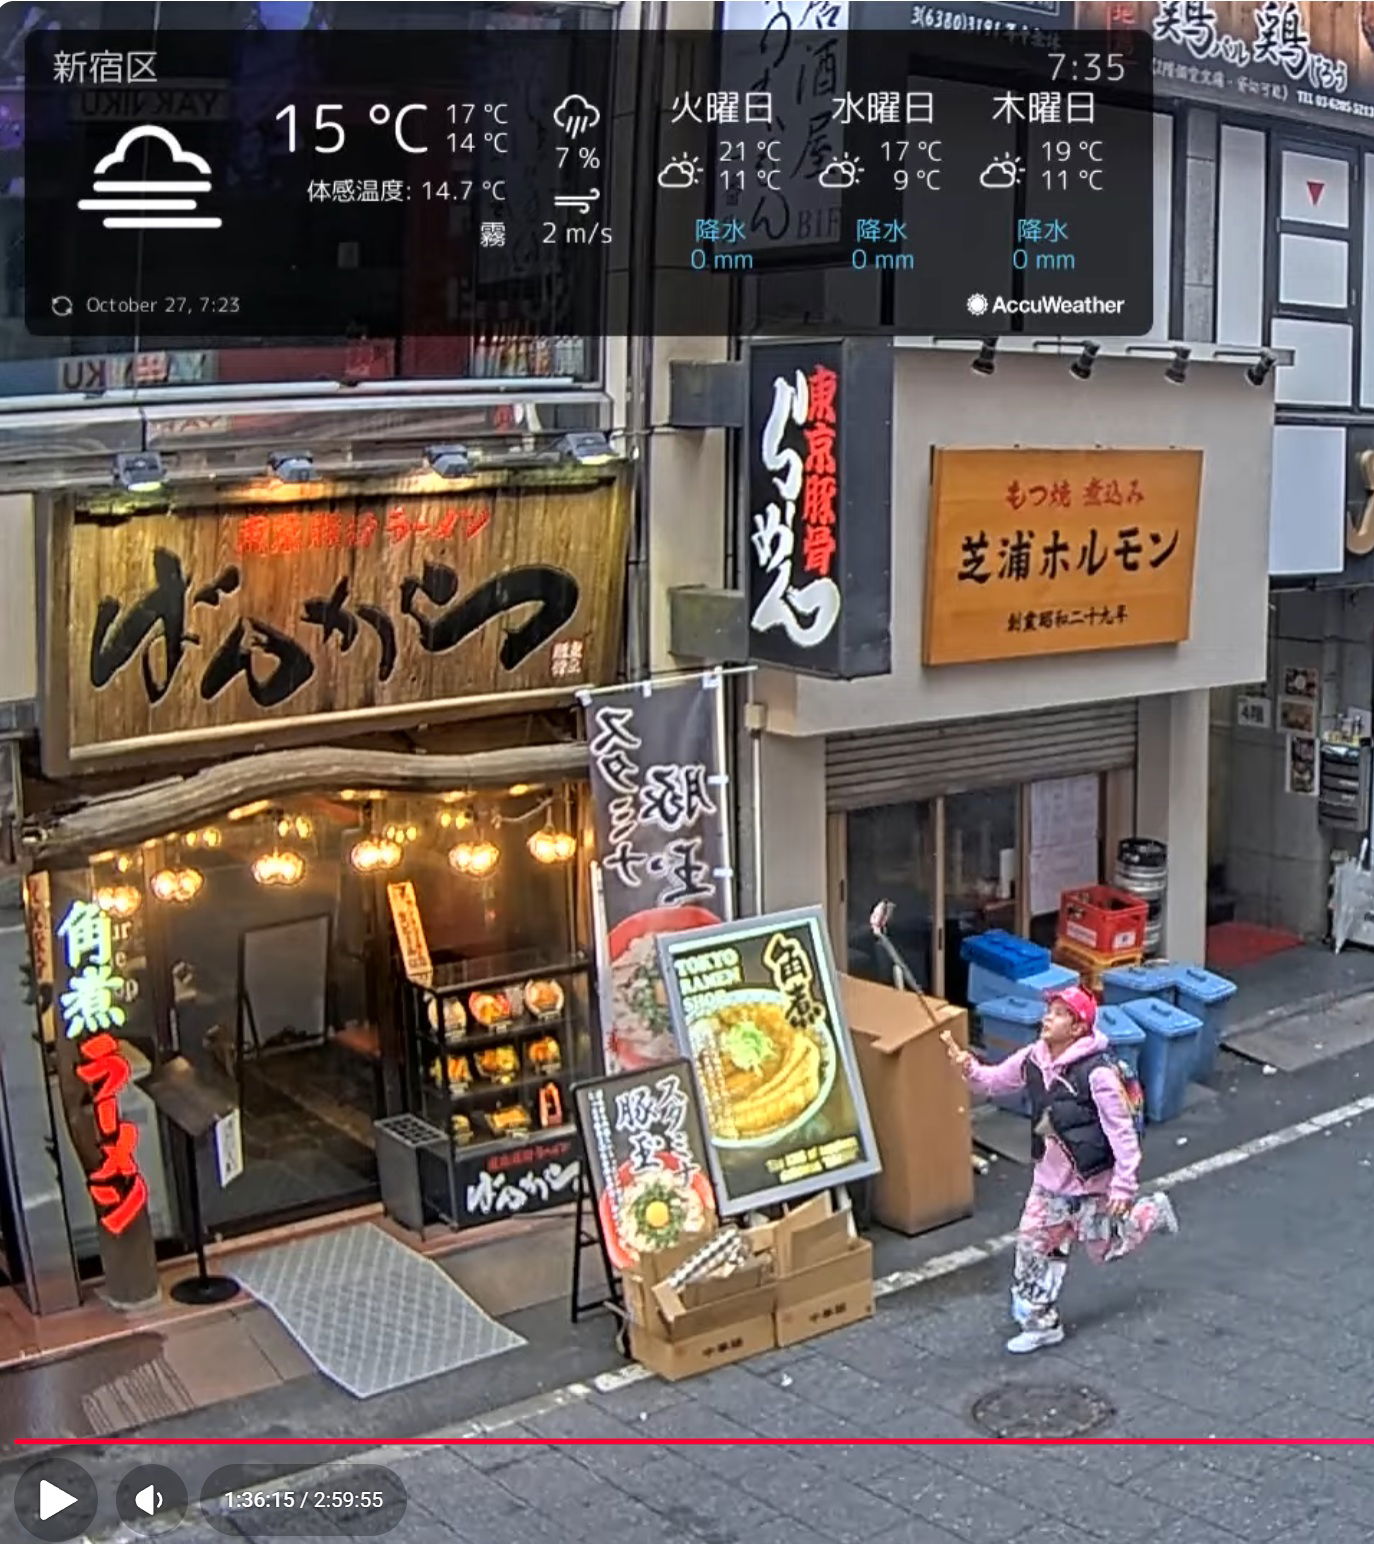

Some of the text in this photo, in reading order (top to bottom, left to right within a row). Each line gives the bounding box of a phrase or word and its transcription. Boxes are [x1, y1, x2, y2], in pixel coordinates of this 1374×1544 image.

[803, 365, 838, 575] 東京豚骨
[958, 527, 1180, 585] 芝浦ホルモン
[91, 545, 580, 708] ばんから
[674, 948, 739, 977] TOKYO
[615, 1086, 665, 1173] 豚玉
